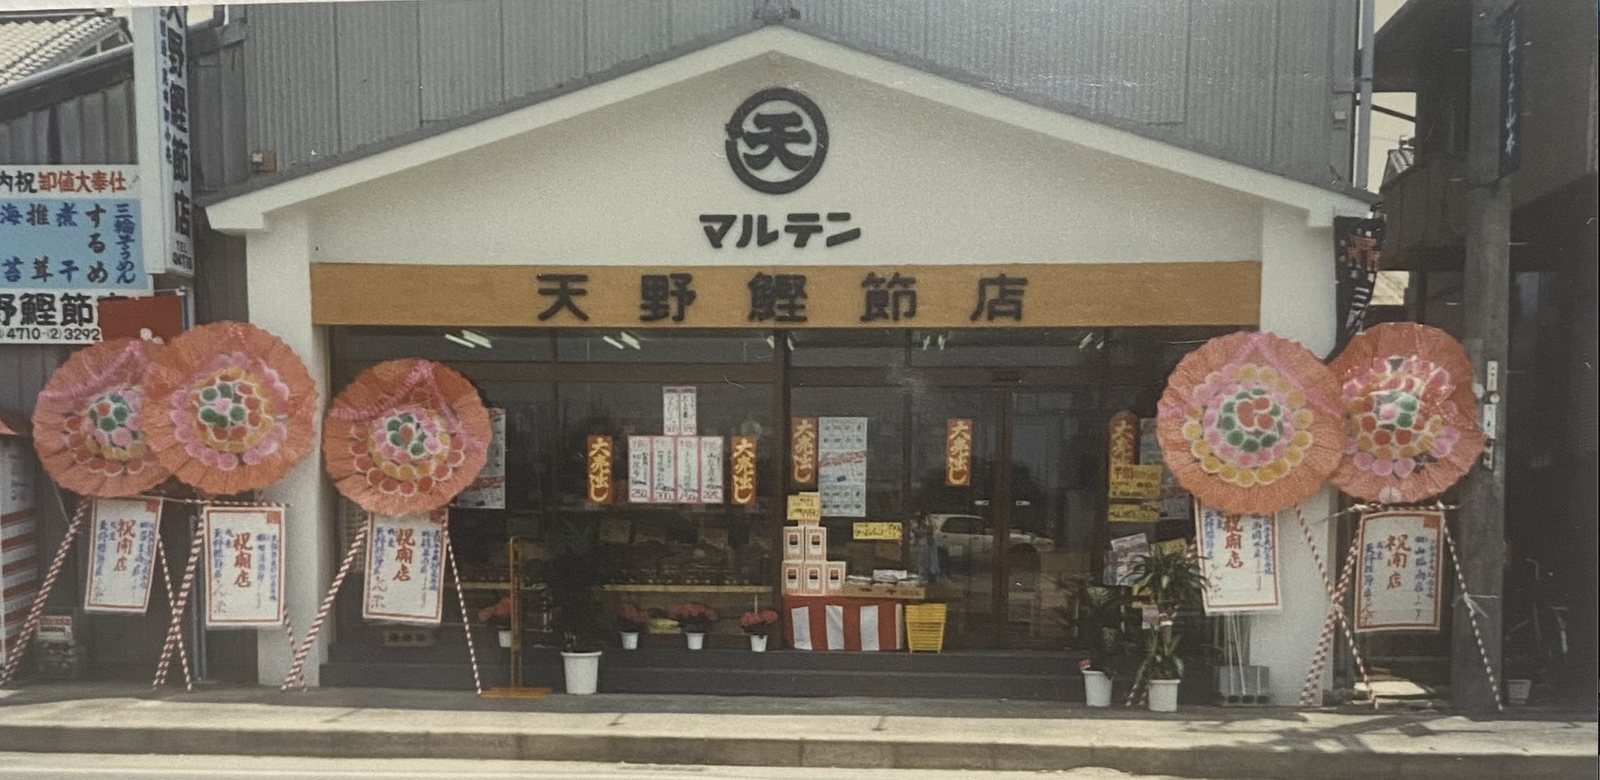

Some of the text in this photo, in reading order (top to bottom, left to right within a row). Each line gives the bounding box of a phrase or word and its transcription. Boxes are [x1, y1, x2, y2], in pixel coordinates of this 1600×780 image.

[86, 203, 110, 284] するめ
[699, 212, 861, 249] マルテン
[537, 272, 1028, 322] 天野鰹節店
[589, 437, 611, 502] 大売出し
[732, 438, 756, 503] 大売出し
[792, 419, 816, 483] 大売出し
[948, 420, 971, 485] 大売出し
[114, 519, 136, 572] 祝開店
[393, 528, 416, 582] 祝開店
[1385, 534, 1411, 590] 祝開店
